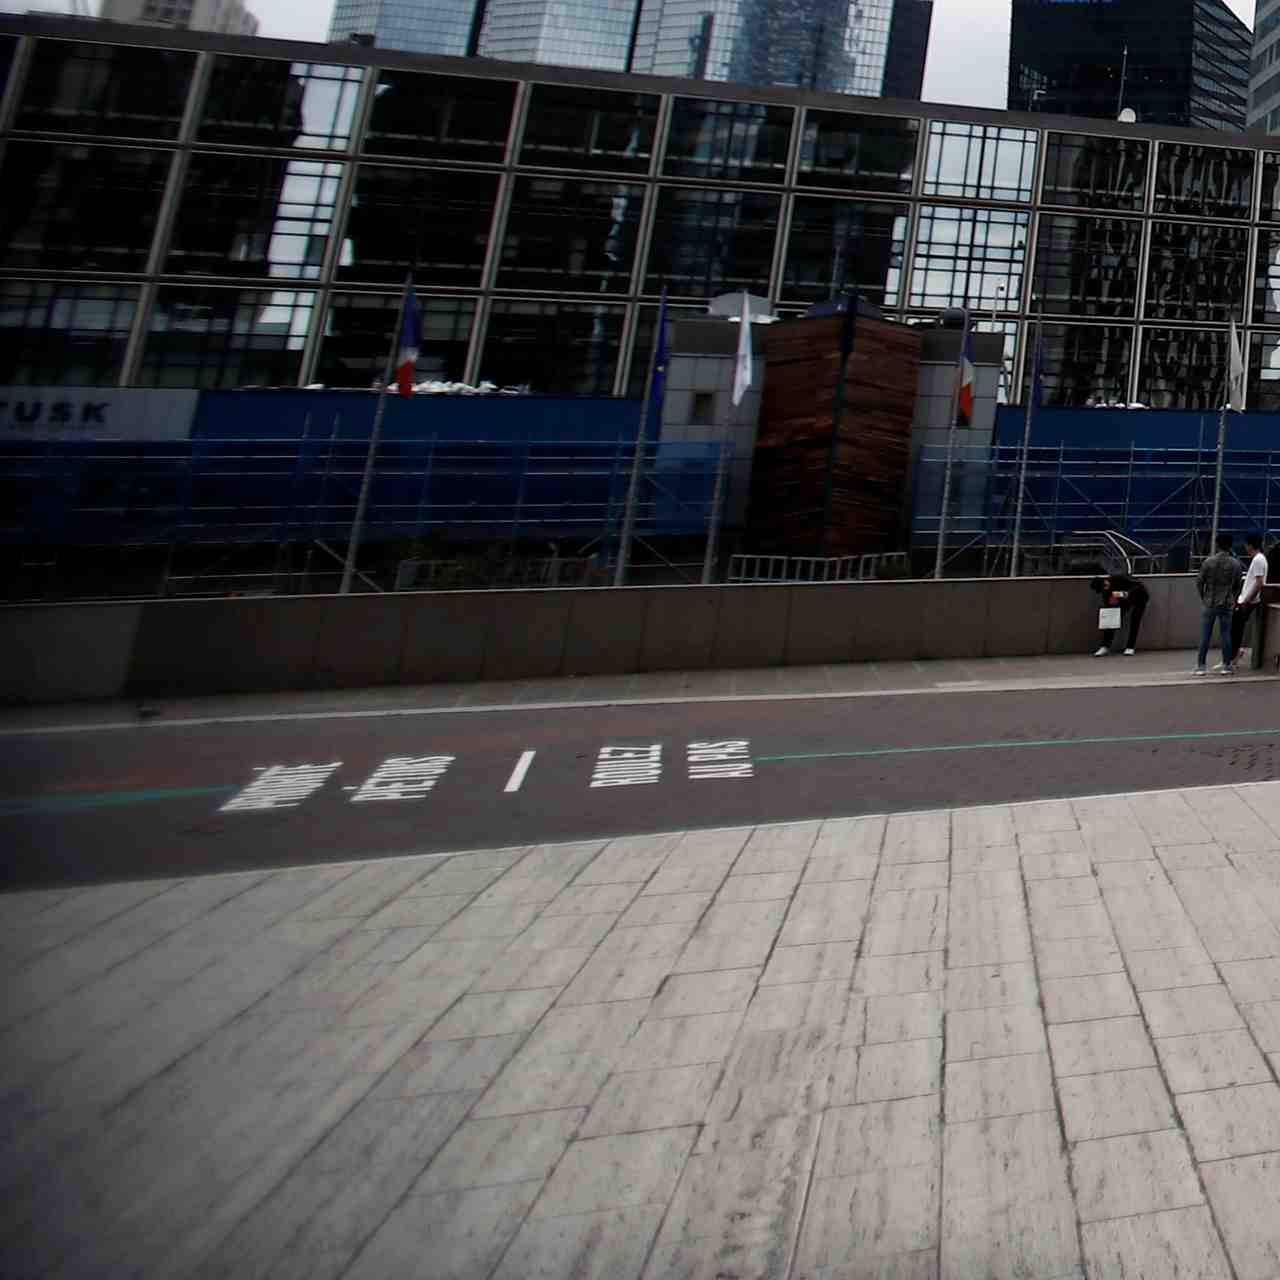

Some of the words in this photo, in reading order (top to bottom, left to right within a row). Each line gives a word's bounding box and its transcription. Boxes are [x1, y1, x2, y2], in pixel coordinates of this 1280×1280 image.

[686, 740, 750, 762] PAS
[588, 744, 663, 788] ROULEZ
[687, 762, 755, 780] AU
